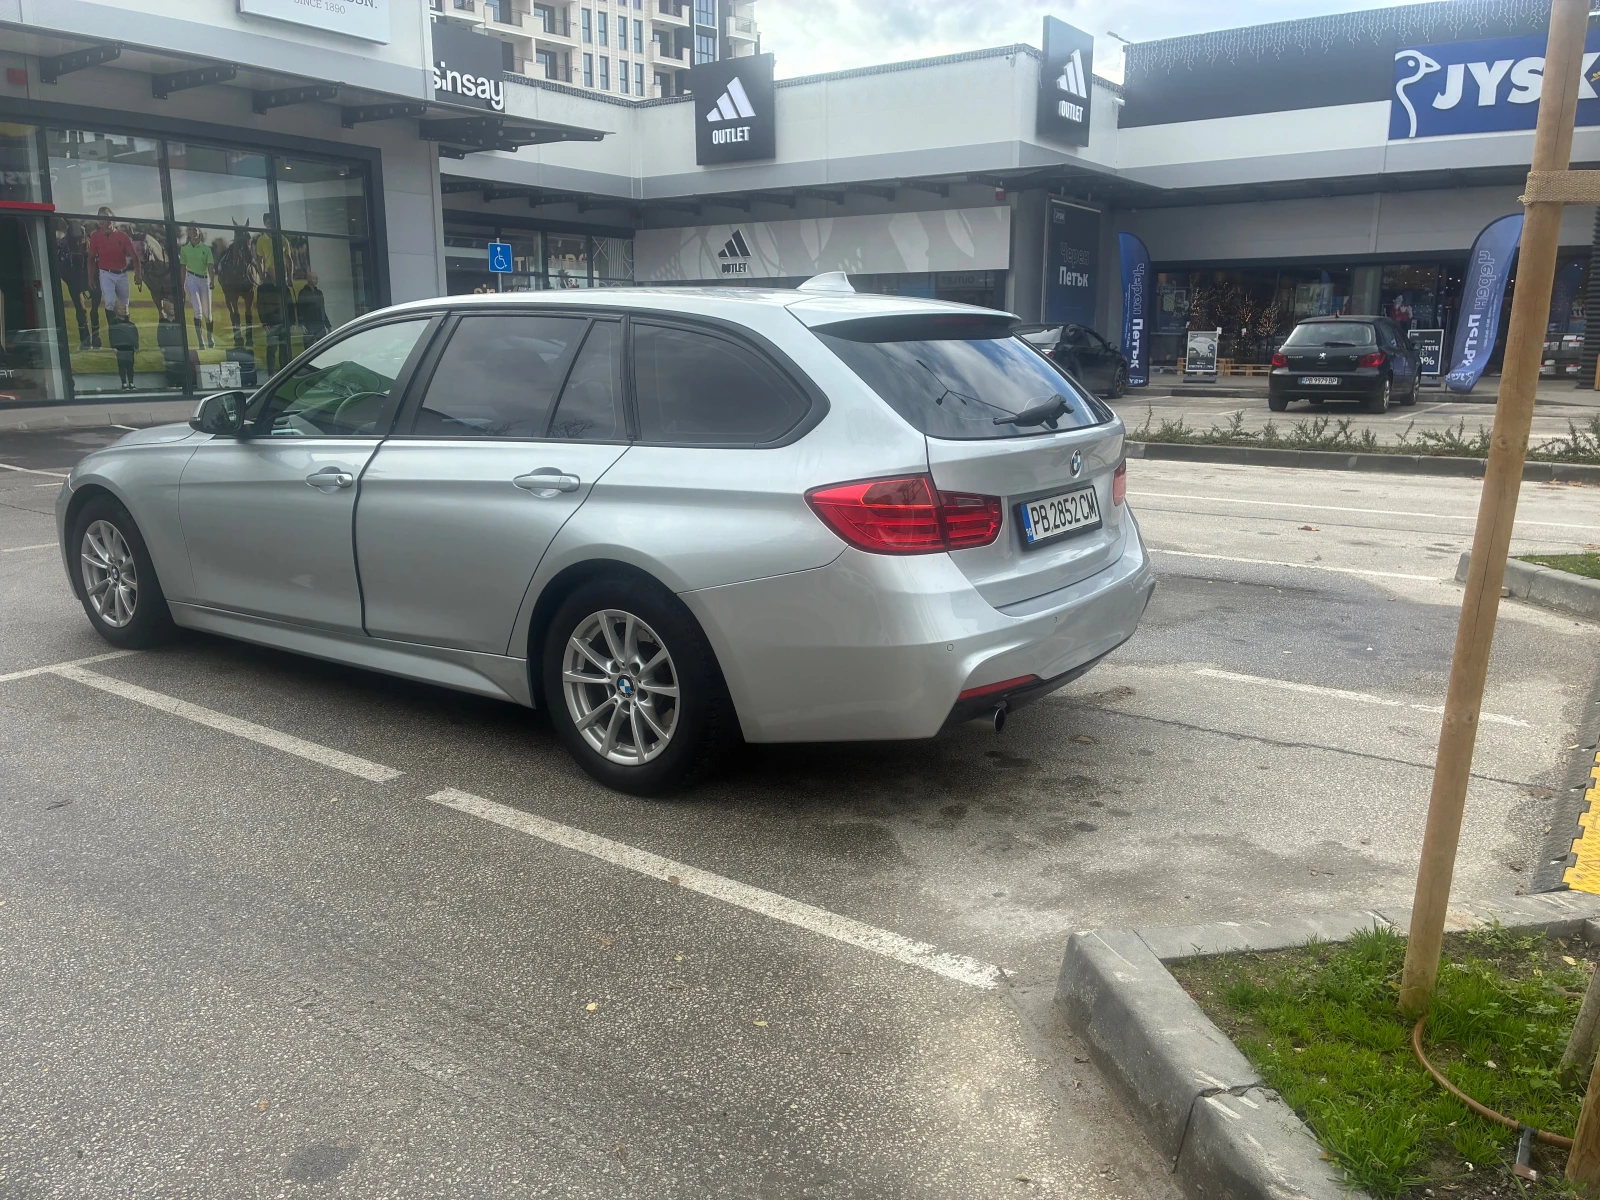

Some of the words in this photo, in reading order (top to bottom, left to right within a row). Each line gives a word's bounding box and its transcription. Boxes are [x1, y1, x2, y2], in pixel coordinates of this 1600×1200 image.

[325, 2, 346, 14] 1890
[433, 61, 504, 110] sinsay
[1058, 100, 1083, 122] OUTLET
[712, 127, 750, 144] OUTLET
[1060, 242, 1090, 268] Черен
[721, 263, 748, 274] OUTLET
[1059, 266, 1089, 287] Петък
[1131, 263, 1145, 315] Черен
[1129, 318, 1144, 369] Петък
